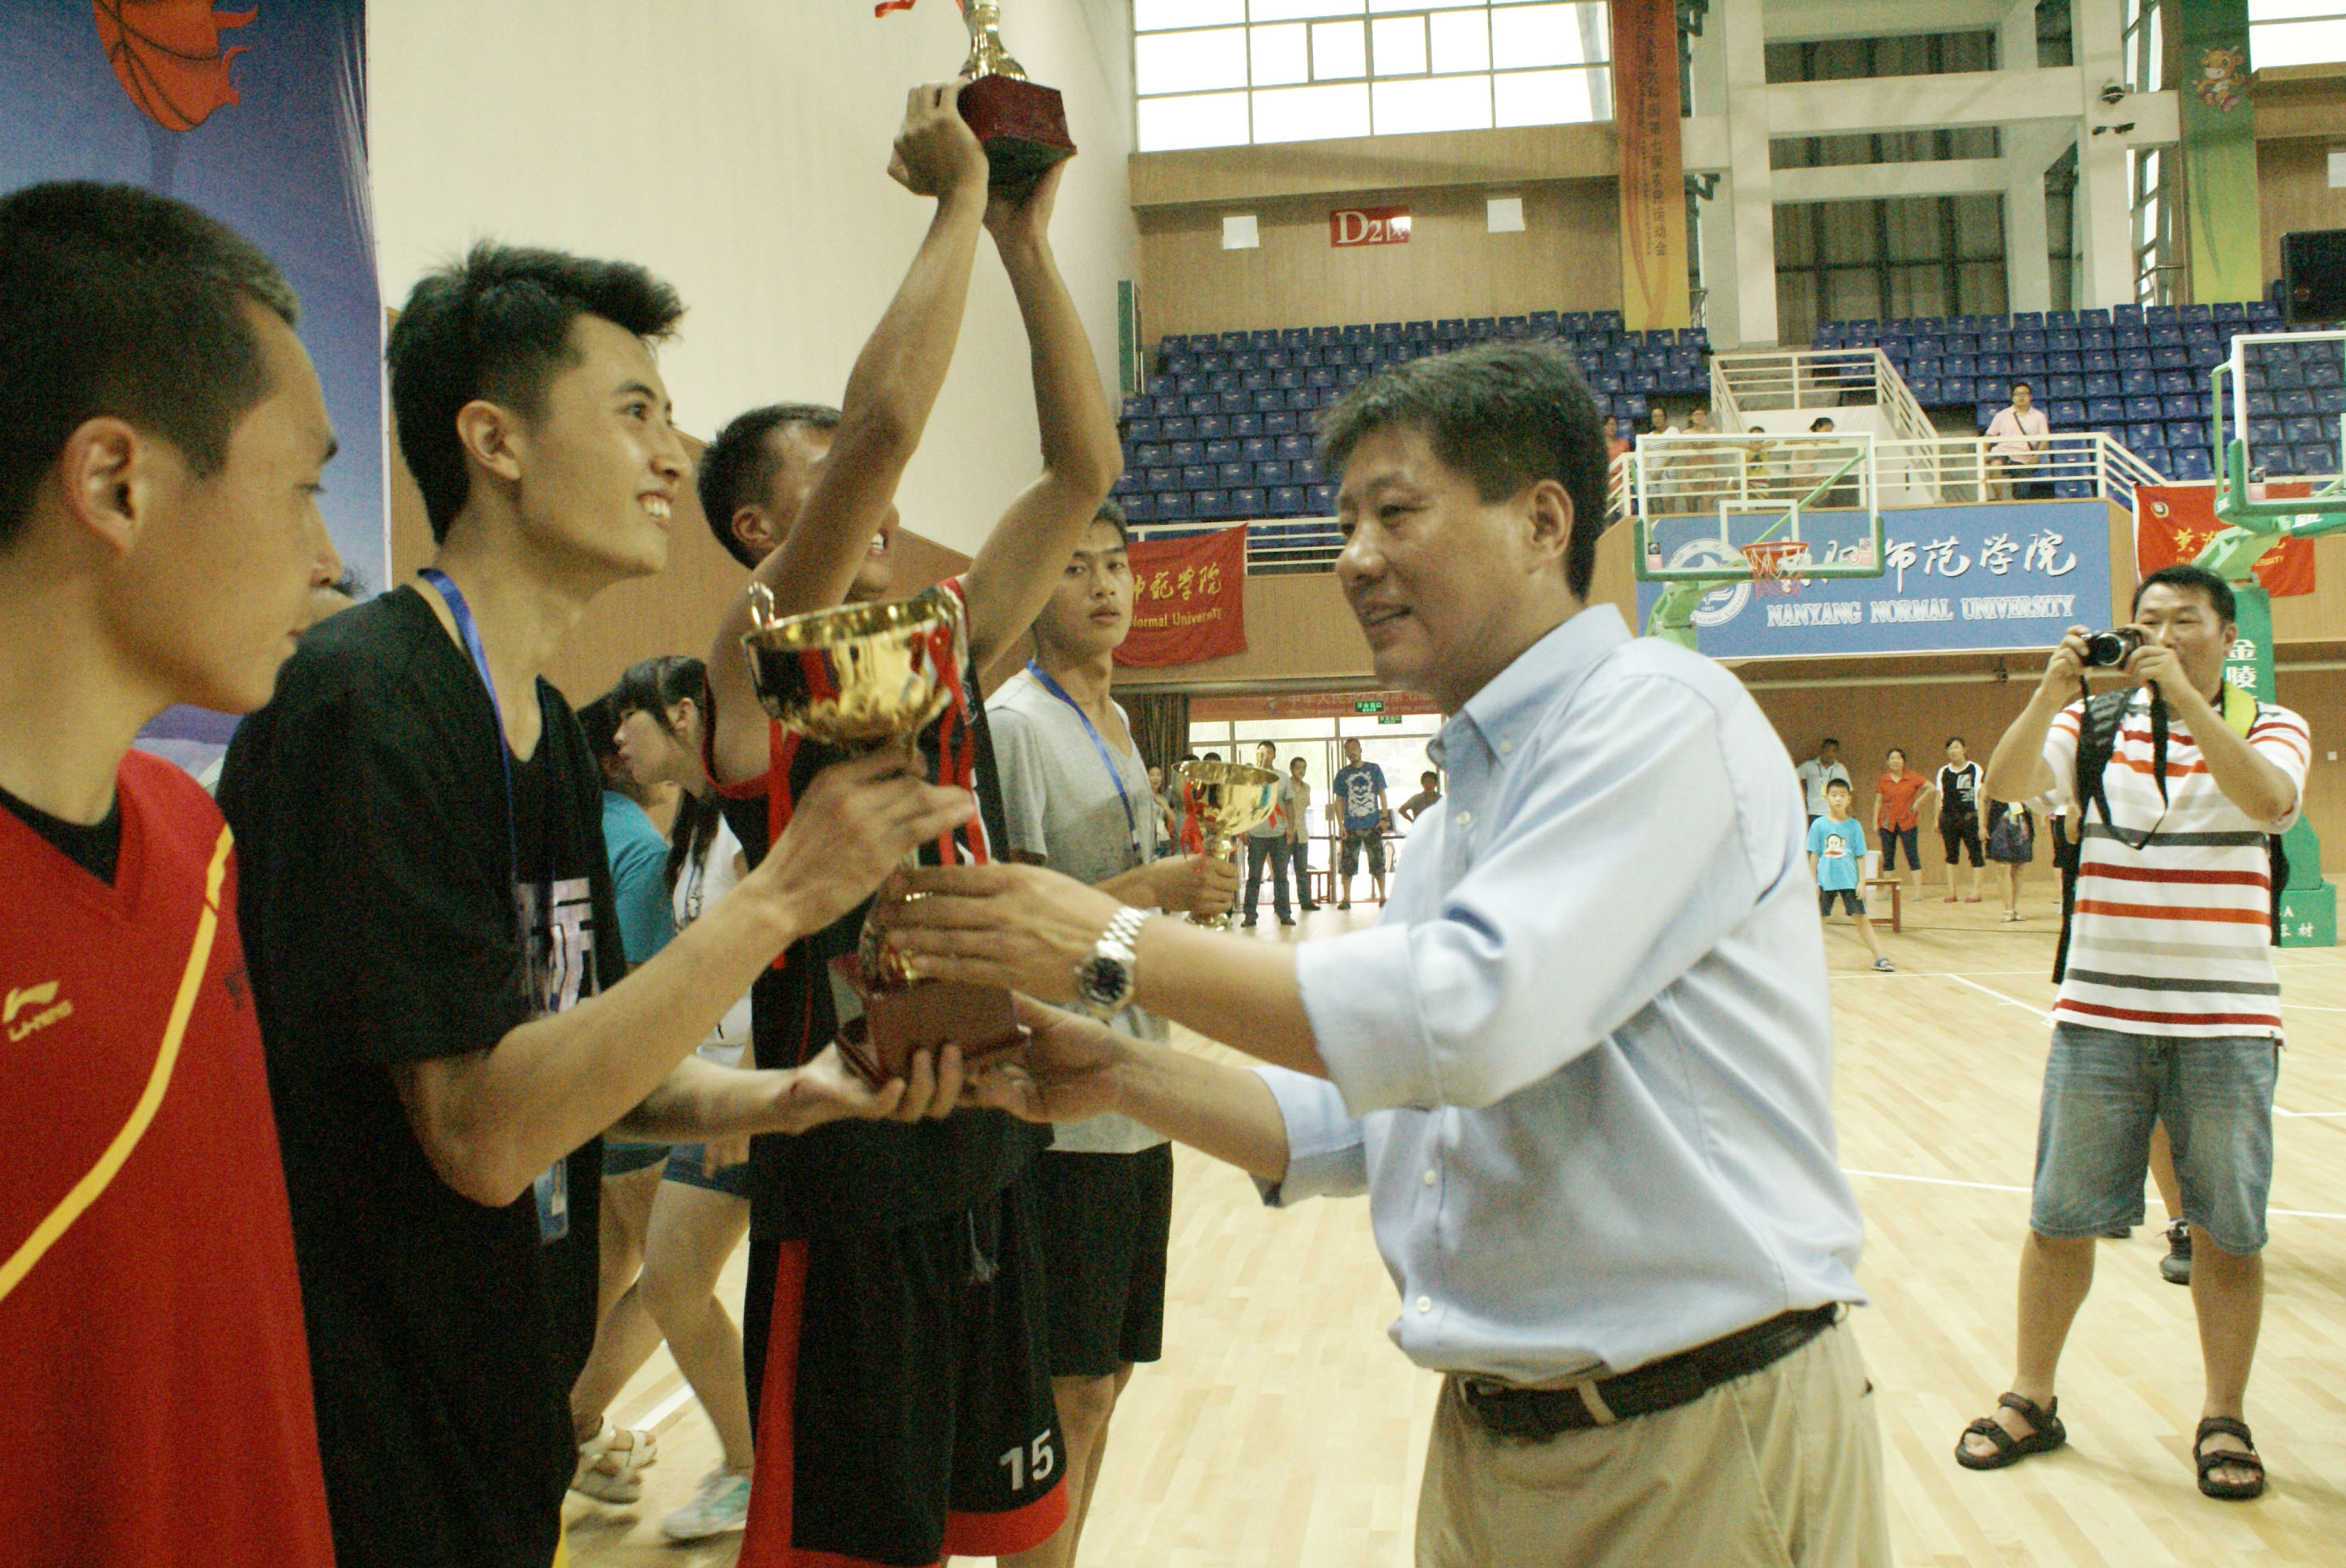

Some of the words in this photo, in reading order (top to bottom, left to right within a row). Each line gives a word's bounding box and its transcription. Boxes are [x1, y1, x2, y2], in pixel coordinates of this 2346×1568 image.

[1134, 614, 1167, 628] ormal
[1767, 602, 1862, 627] NANYANG
[1870, 599, 1954, 624] NORMAL
[1960, 594, 2075, 620] UNIVERSITY
[999, 1428, 1054, 1490] 15
